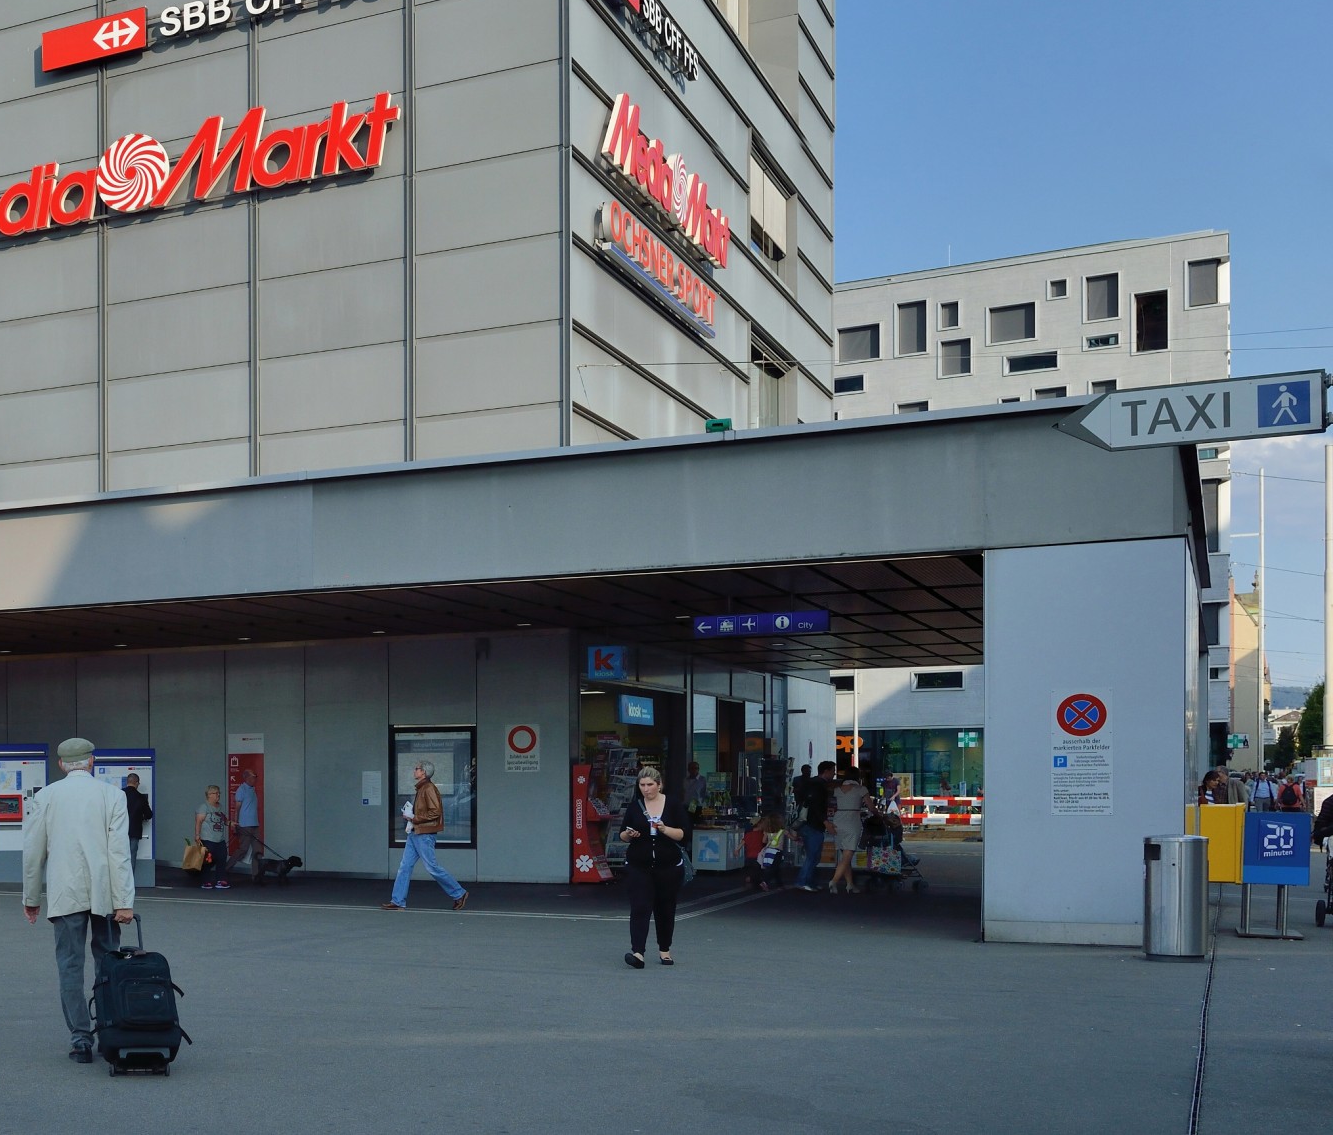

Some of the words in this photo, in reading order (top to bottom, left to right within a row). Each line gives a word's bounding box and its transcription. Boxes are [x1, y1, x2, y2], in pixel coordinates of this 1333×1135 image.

[664, 16, 682, 59] CFF
[683, 39, 699, 81] FFS
[610, 200, 675, 292] OCHSNER
[676, 261, 718, 327] SPORT
[1121, 391, 1231, 437] TAXI
[628, 702, 642, 718] kiosk
[836, 735, 864, 753] op
[1263, 823, 1294, 849] 20
[1263, 849, 1293, 857] minuten
